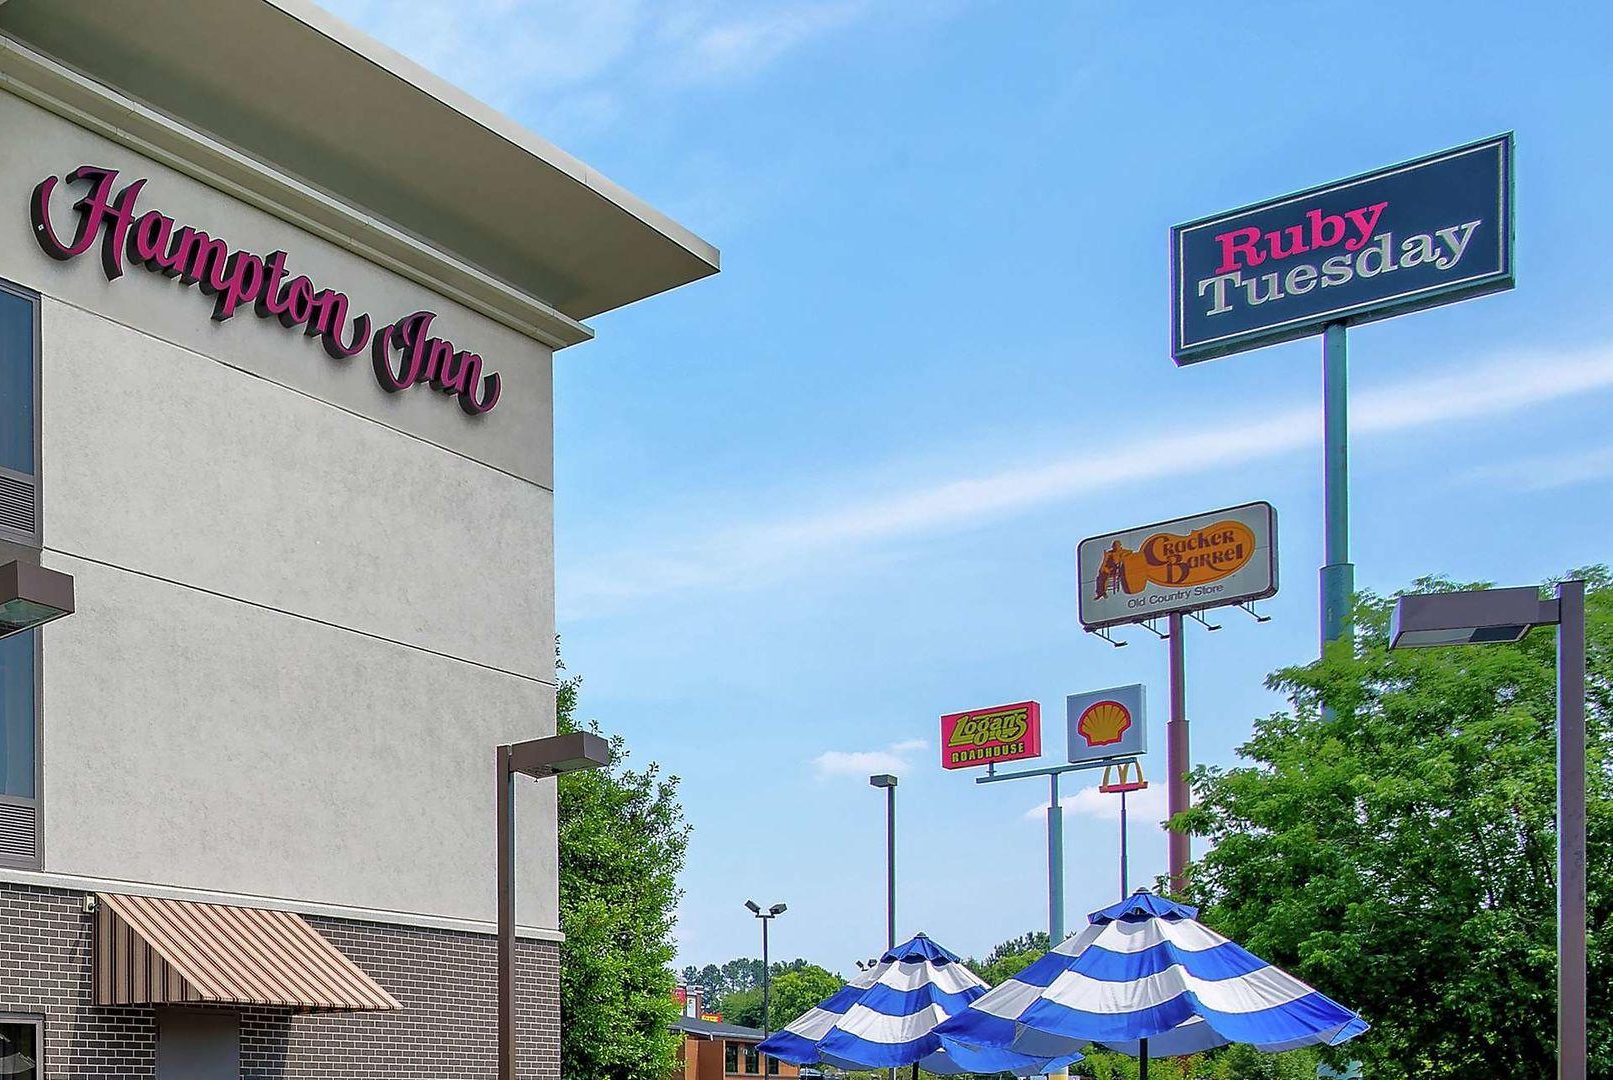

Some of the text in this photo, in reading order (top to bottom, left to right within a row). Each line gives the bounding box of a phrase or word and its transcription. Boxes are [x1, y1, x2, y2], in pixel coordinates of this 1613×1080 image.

[1214, 201, 1389, 275] Ruby
[1197, 218, 1482, 317] Tuesday
[29, 165, 502, 416] Hampton Inn
[1144, 530, 1235, 567] Cracker
[1165, 543, 1244, 584] Barrel
[1127, 583, 1224, 608] Old Country Store
[952, 742, 1025, 763] ROADHOUSE
